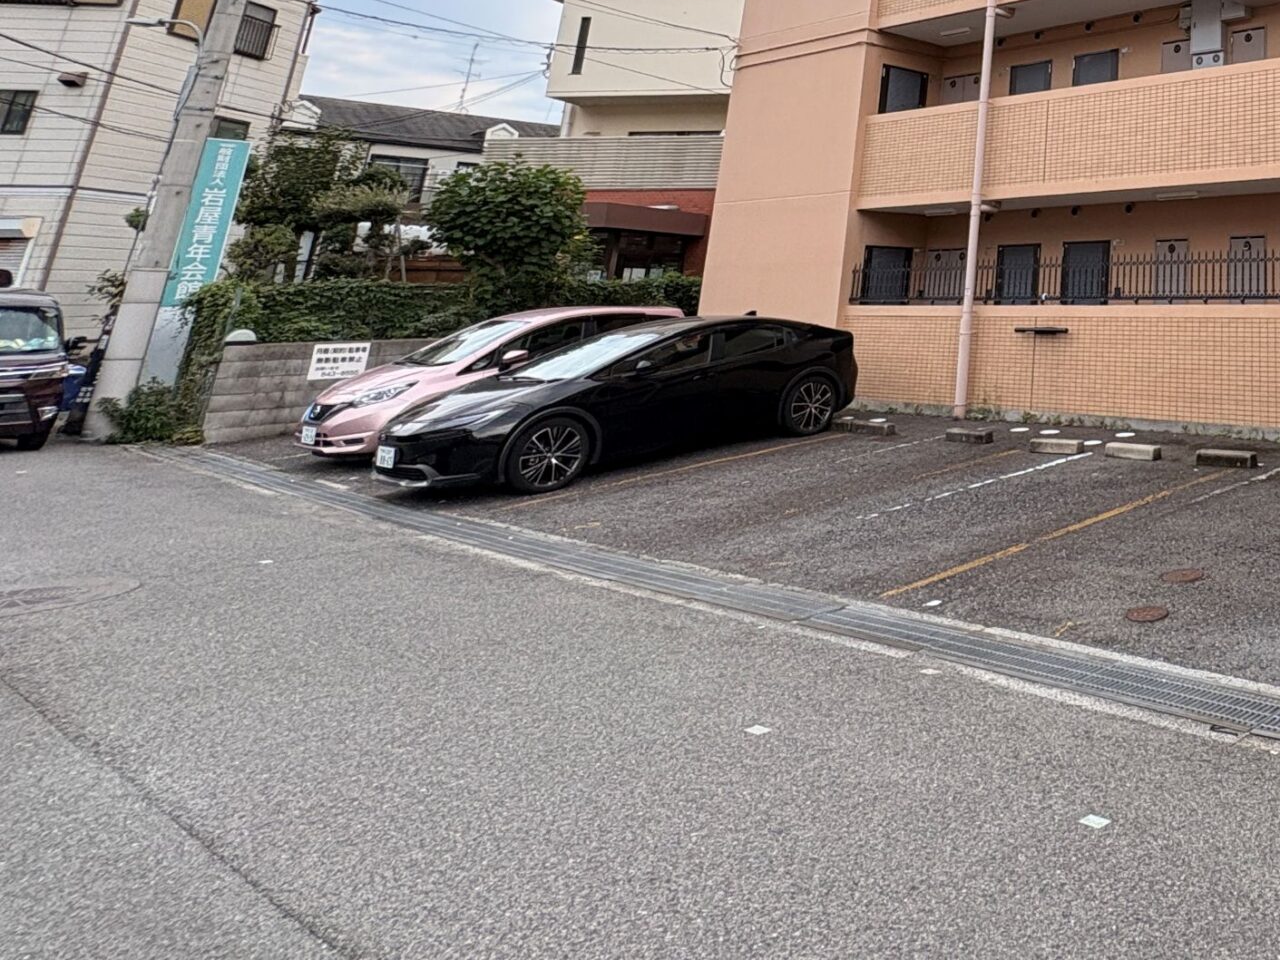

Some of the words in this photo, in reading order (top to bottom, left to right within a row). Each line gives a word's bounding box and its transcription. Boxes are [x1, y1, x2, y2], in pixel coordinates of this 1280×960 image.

[210, 143, 237, 186] 一般財団法人
[174, 188, 227, 300] 岩屋青年会館
